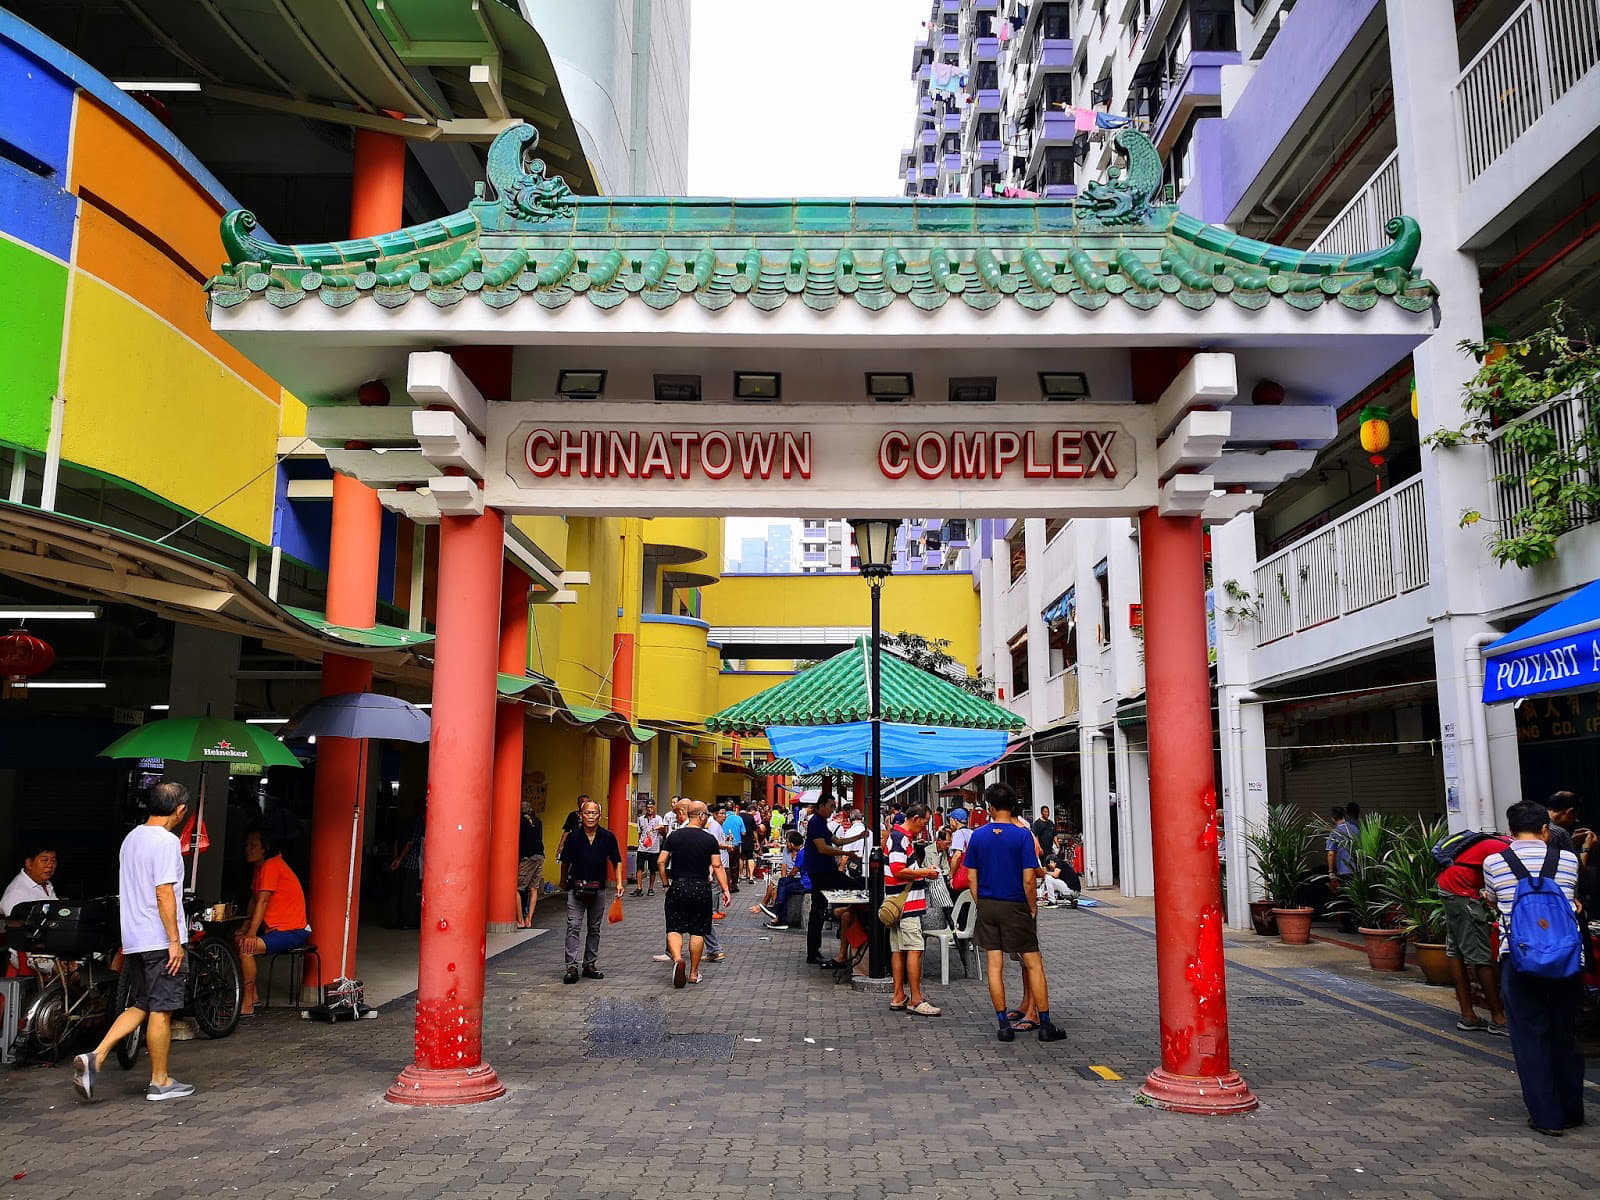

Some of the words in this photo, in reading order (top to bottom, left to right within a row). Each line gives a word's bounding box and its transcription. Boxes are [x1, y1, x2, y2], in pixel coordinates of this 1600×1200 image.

[524, 429, 811, 479] CHINATOWN
[878, 430, 1118, 480] COMPLEX
[1497, 644, 1580, 691] POLYART
[203, 748, 249, 758] Heineken
